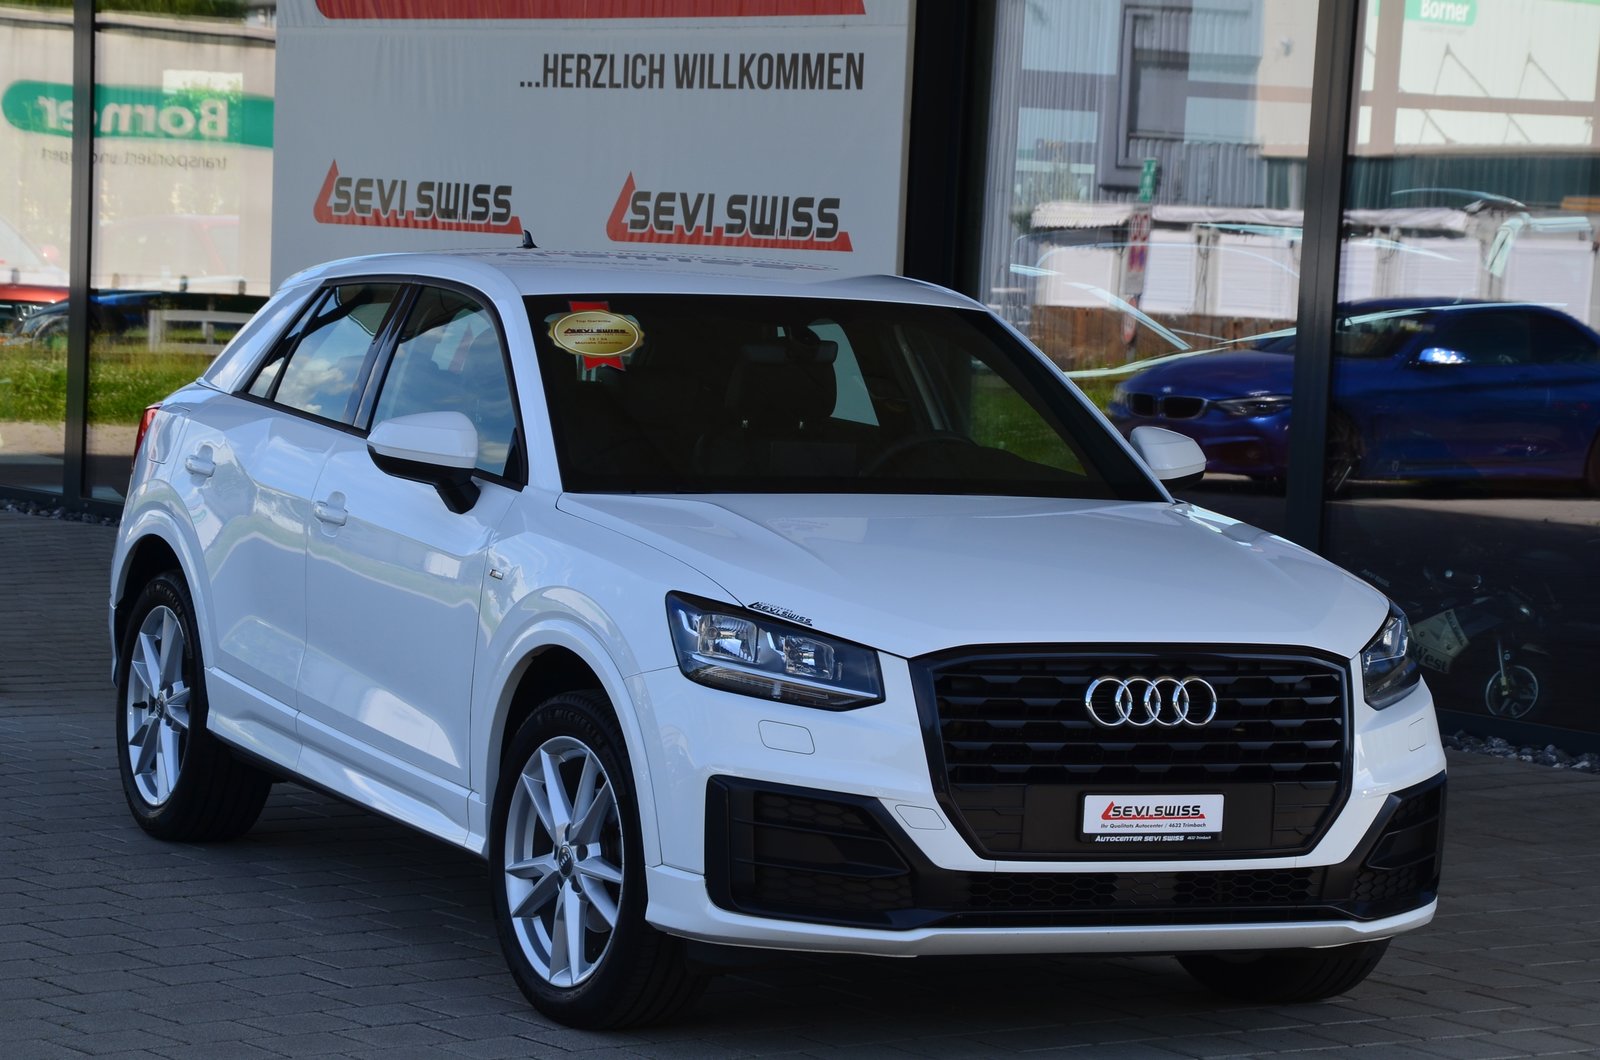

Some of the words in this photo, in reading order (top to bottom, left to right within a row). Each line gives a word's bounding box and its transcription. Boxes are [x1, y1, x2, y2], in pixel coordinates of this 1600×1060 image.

[1421, 0, 1470, 22] Borner
[519, 52, 665, 89] ...HERZLICH
[674, 52, 864, 90] WILLKOMMEN
[333, 176, 408, 219] SEVI
[414, 181, 513, 223] SWISS
[628, 190, 716, 234] SEVI
[723, 194, 841, 239] SWISS
[781, 611, 812, 624] SWISS
[1112, 805, 1150, 817] SEVI
[1154, 805, 1201, 817] SWISS
